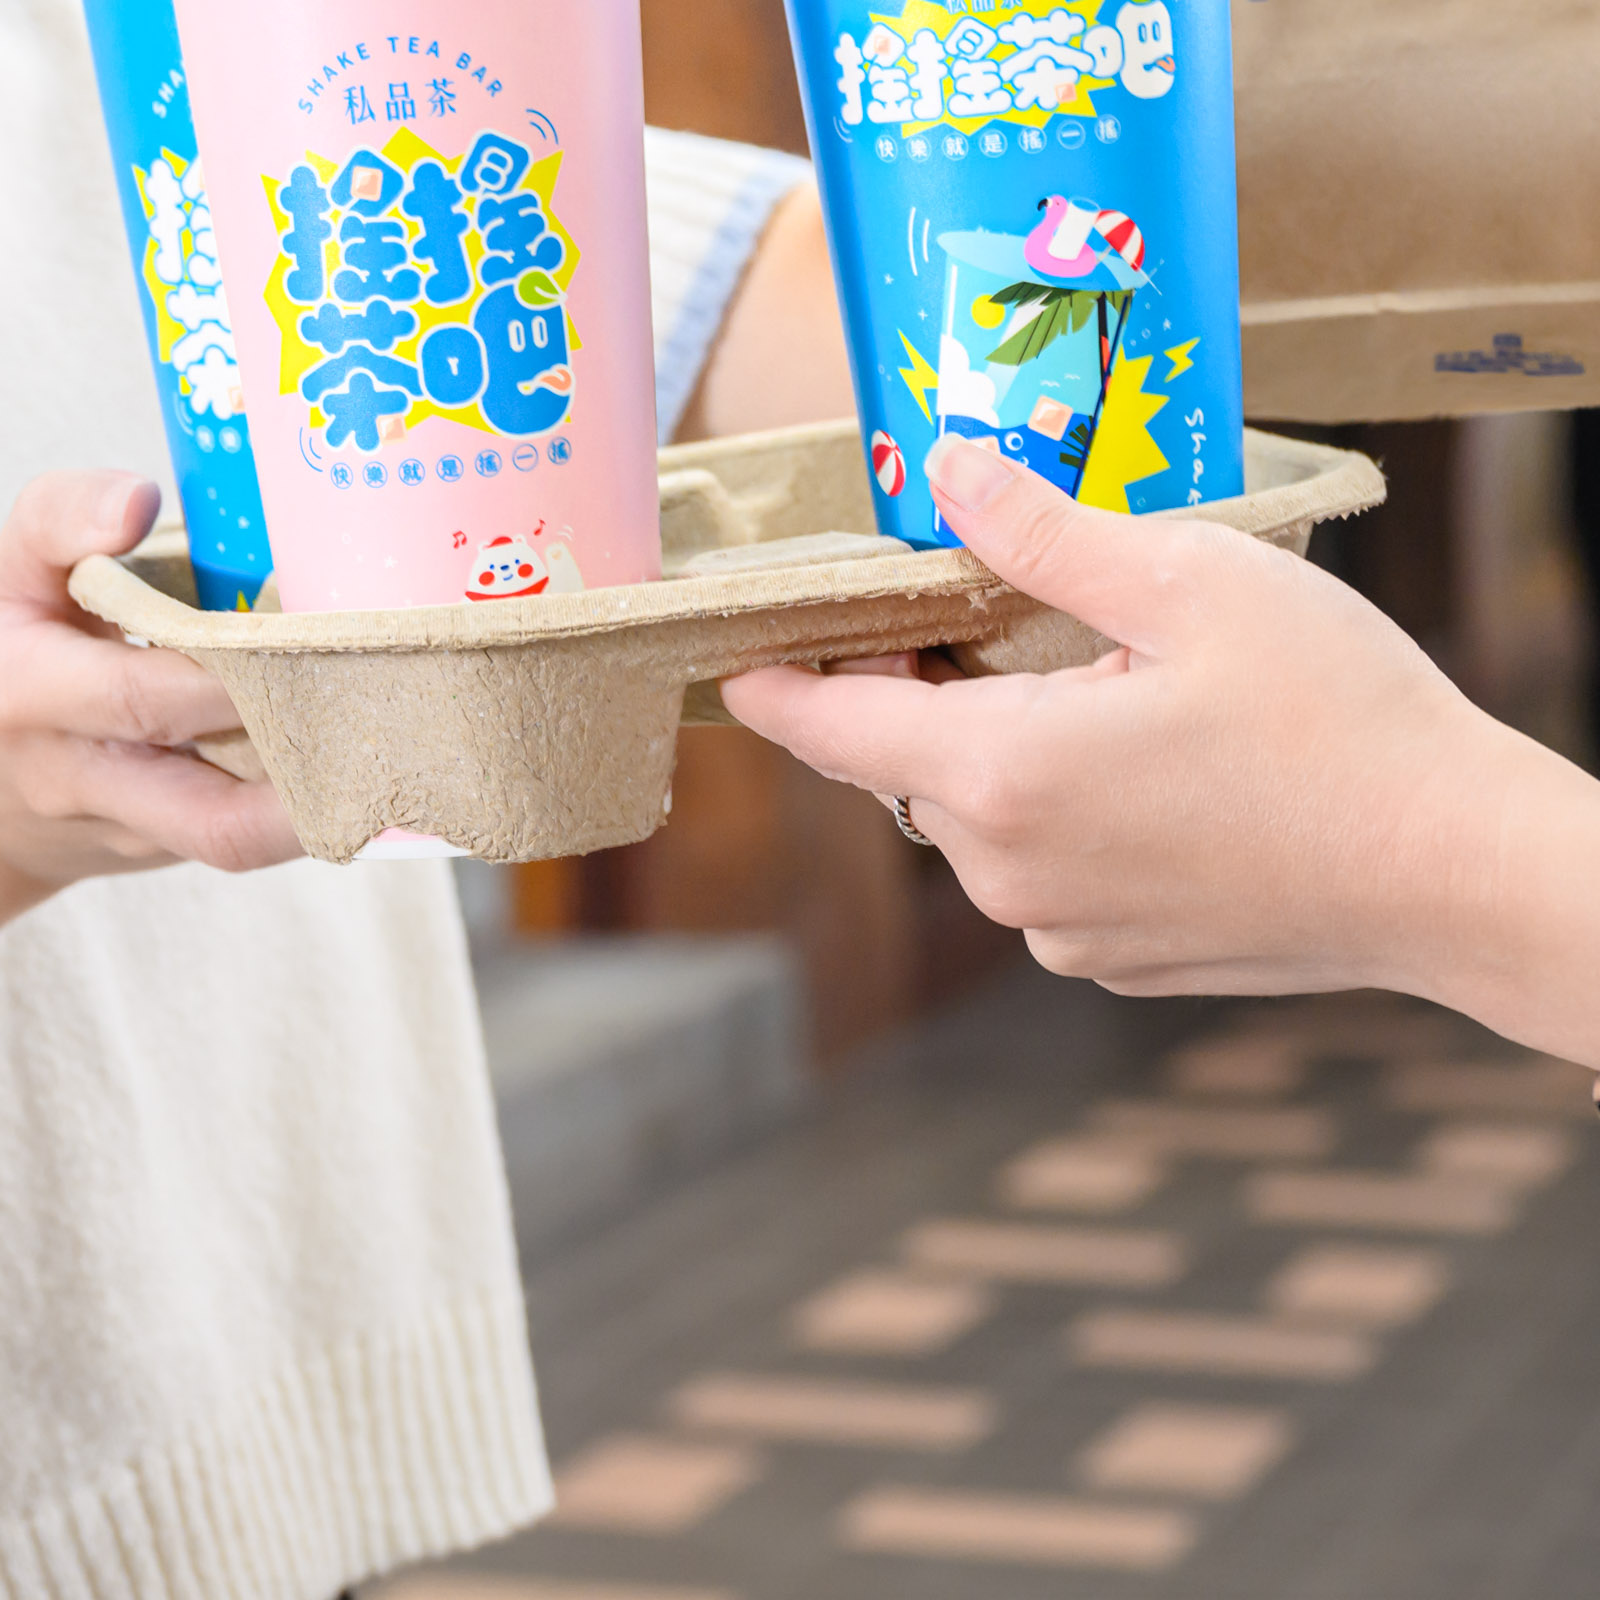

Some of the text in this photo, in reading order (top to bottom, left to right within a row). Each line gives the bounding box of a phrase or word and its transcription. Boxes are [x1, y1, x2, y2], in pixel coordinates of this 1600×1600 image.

[152, 60, 185, 119] SHA
[298, 36, 504, 115] SHAKE TEA BAR
[343, 77, 457, 126] 私品茶
[330, 436, 573, 489] 快樂就是搖一搖
